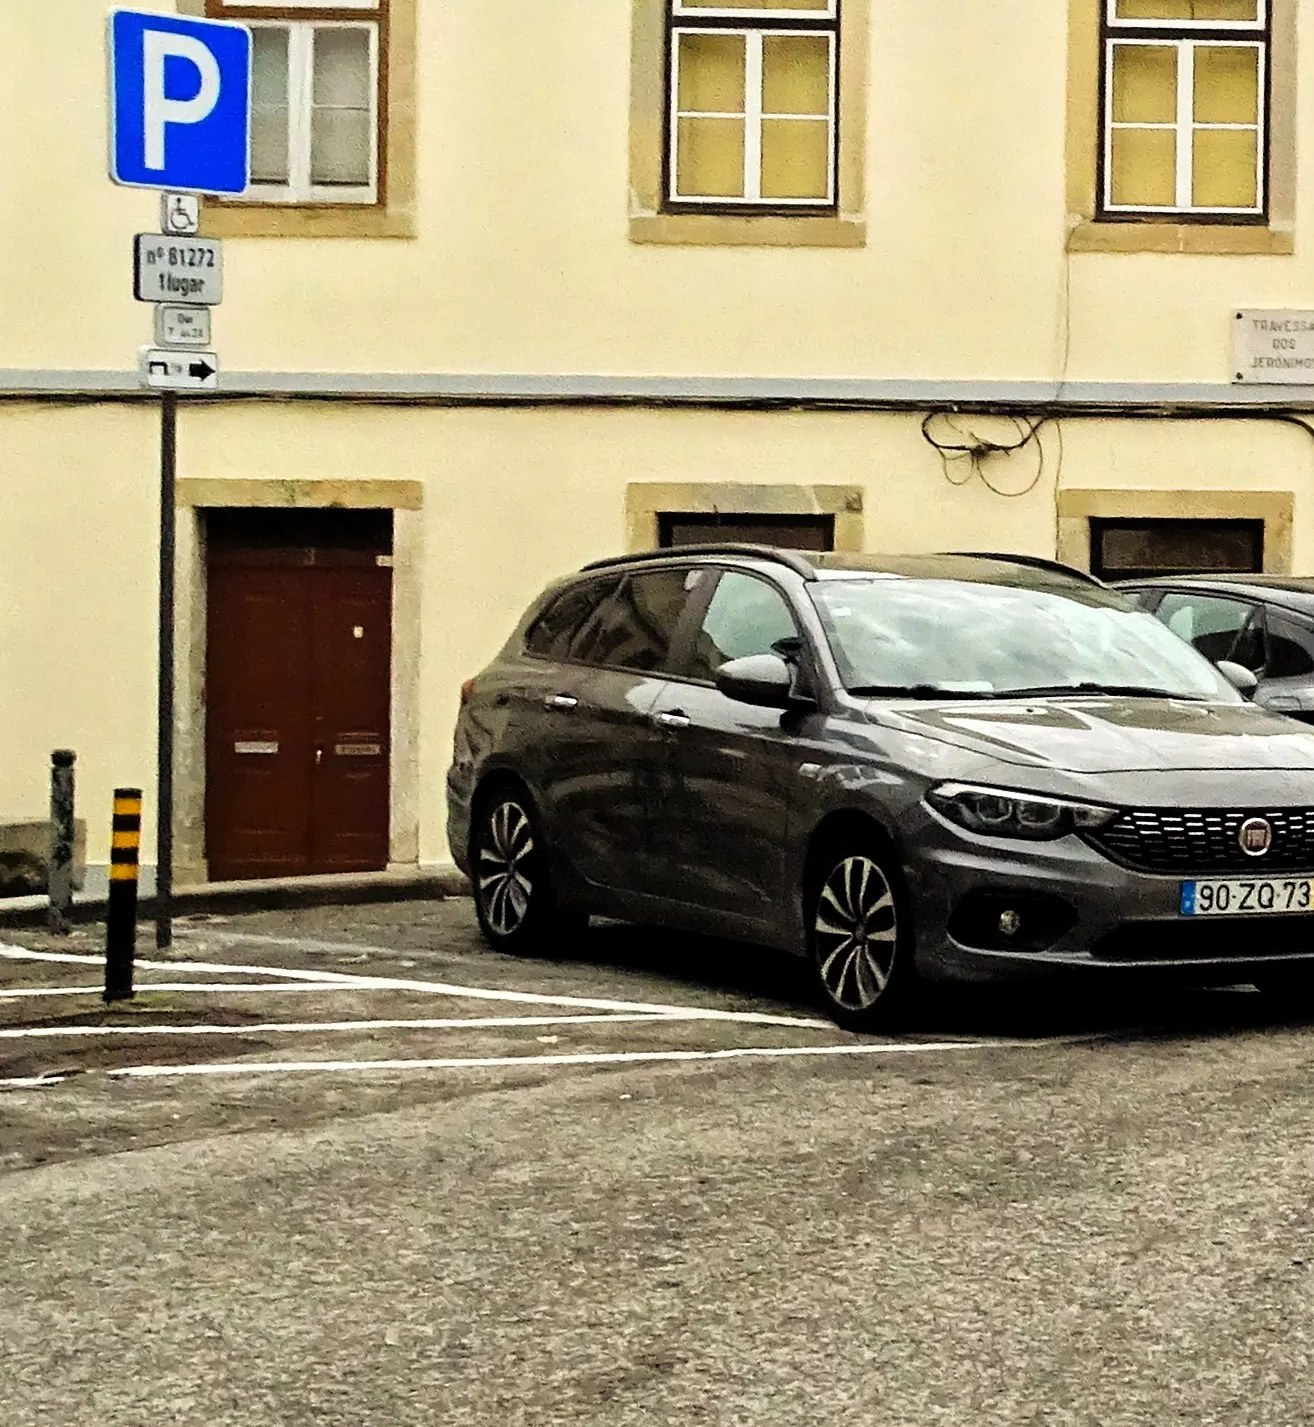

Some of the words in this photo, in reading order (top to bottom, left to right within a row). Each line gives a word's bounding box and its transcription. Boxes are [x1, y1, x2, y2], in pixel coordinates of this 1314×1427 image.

[142, 28, 221, 171] P
[168, 247, 214, 267] 81272
[167, 271, 205, 297] lugar
[1272, 338, 1296, 350] DOS
